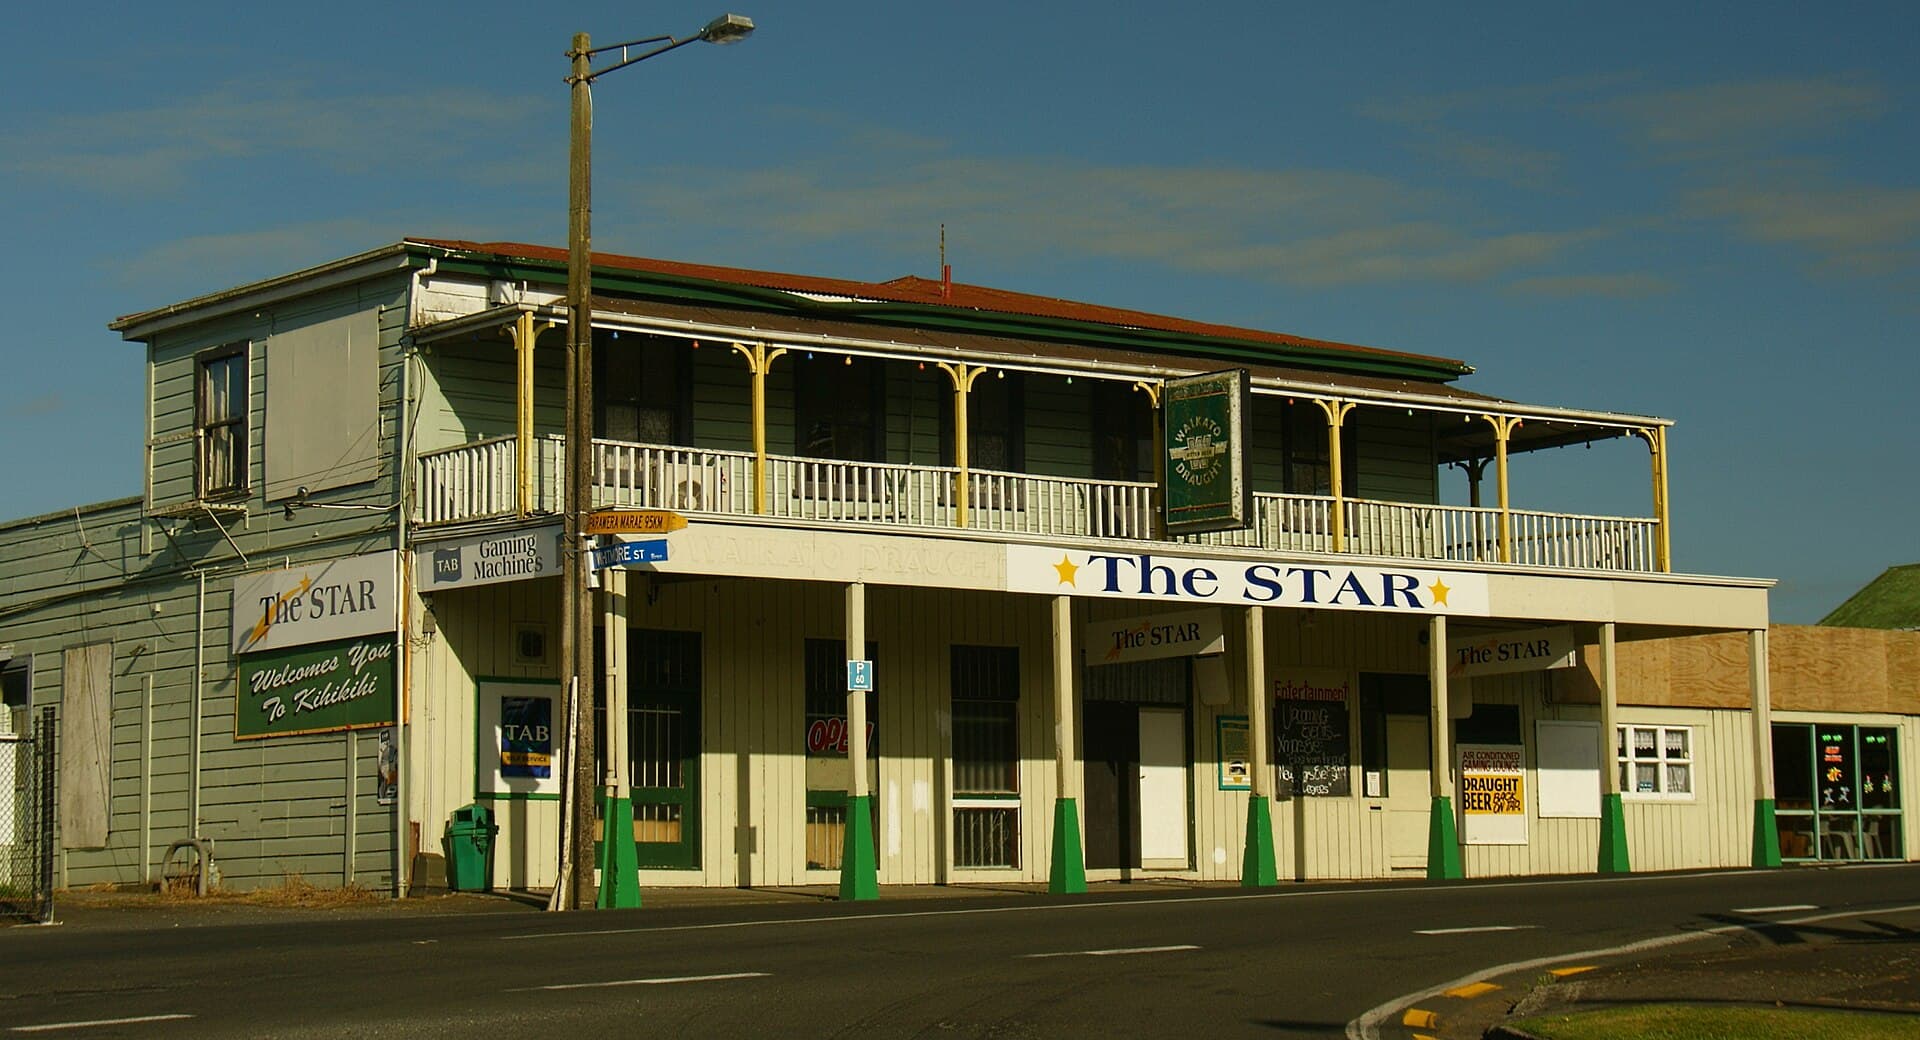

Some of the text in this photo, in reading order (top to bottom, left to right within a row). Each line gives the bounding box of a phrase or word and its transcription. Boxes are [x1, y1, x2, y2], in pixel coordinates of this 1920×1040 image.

[1174, 416, 1222, 443] WAIKATO
[1175, 460, 1222, 486] DRAUGHT
[620, 515, 644, 529] MARAE
[479, 533, 536, 558] Gaming
[633, 549, 646, 560] ST
[436, 558, 459, 573] TAB
[474, 555, 543, 580] Machines
[1087, 554, 1425, 608] The STAR
[259, 580, 376, 626] The STAR
[1112, 622, 1200, 650] The STAR
[1457, 639, 1551, 666] The STAR
[251, 642, 391, 694] Welcomes You
[856, 662, 865, 674] P
[855, 674, 865, 684] 60
[262, 672, 378, 723] To Kihikihi
[1274, 680, 1350, 701] Entertainment
[504, 724, 549, 741] TAB
[1463, 751, 1520, 760] AIR CONDITIONED
[1462, 760, 1520, 773] GAMING LOUNGE
[1463, 778, 1518, 792] DRAUGHT
[1463, 793, 1491, 811] BEER
